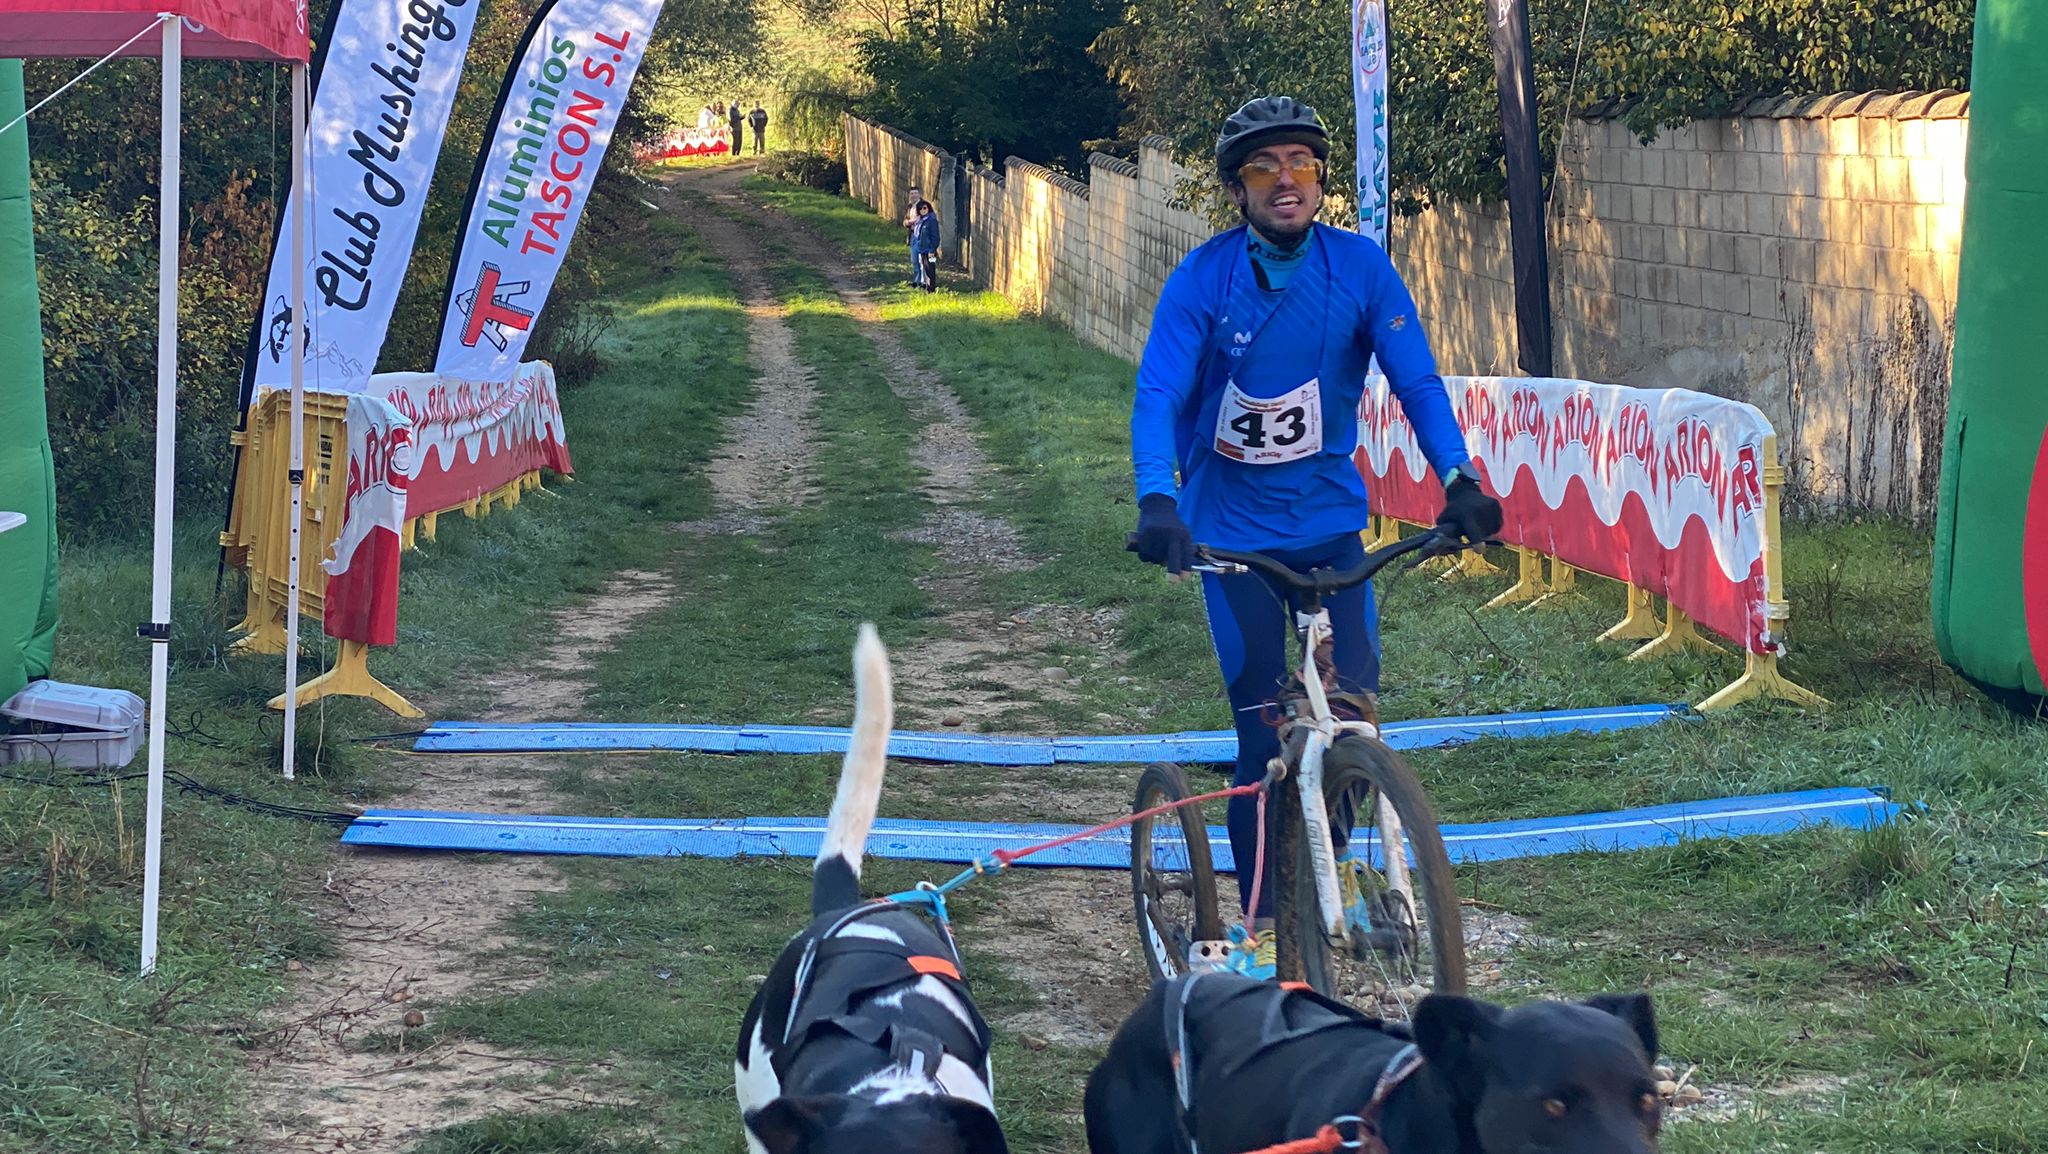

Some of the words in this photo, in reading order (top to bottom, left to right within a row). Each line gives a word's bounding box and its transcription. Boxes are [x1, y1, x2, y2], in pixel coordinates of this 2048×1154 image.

[347, 0, 457, 207] Mushing
[481, 35, 576, 249] Aluminios
[520, 89, 606, 256] TASCON
[582, 30, 631, 88] S.L
[316, 207, 381, 311] Club
[1230, 405, 1307, 449] 43
[1457, 384, 1498, 460] ARION
[1502, 387, 1550, 465] ARION
[1553, 392, 1604, 479] ARION
[1606, 403, 1660, 497] ARION
[1664, 418, 1728, 525] ARION
